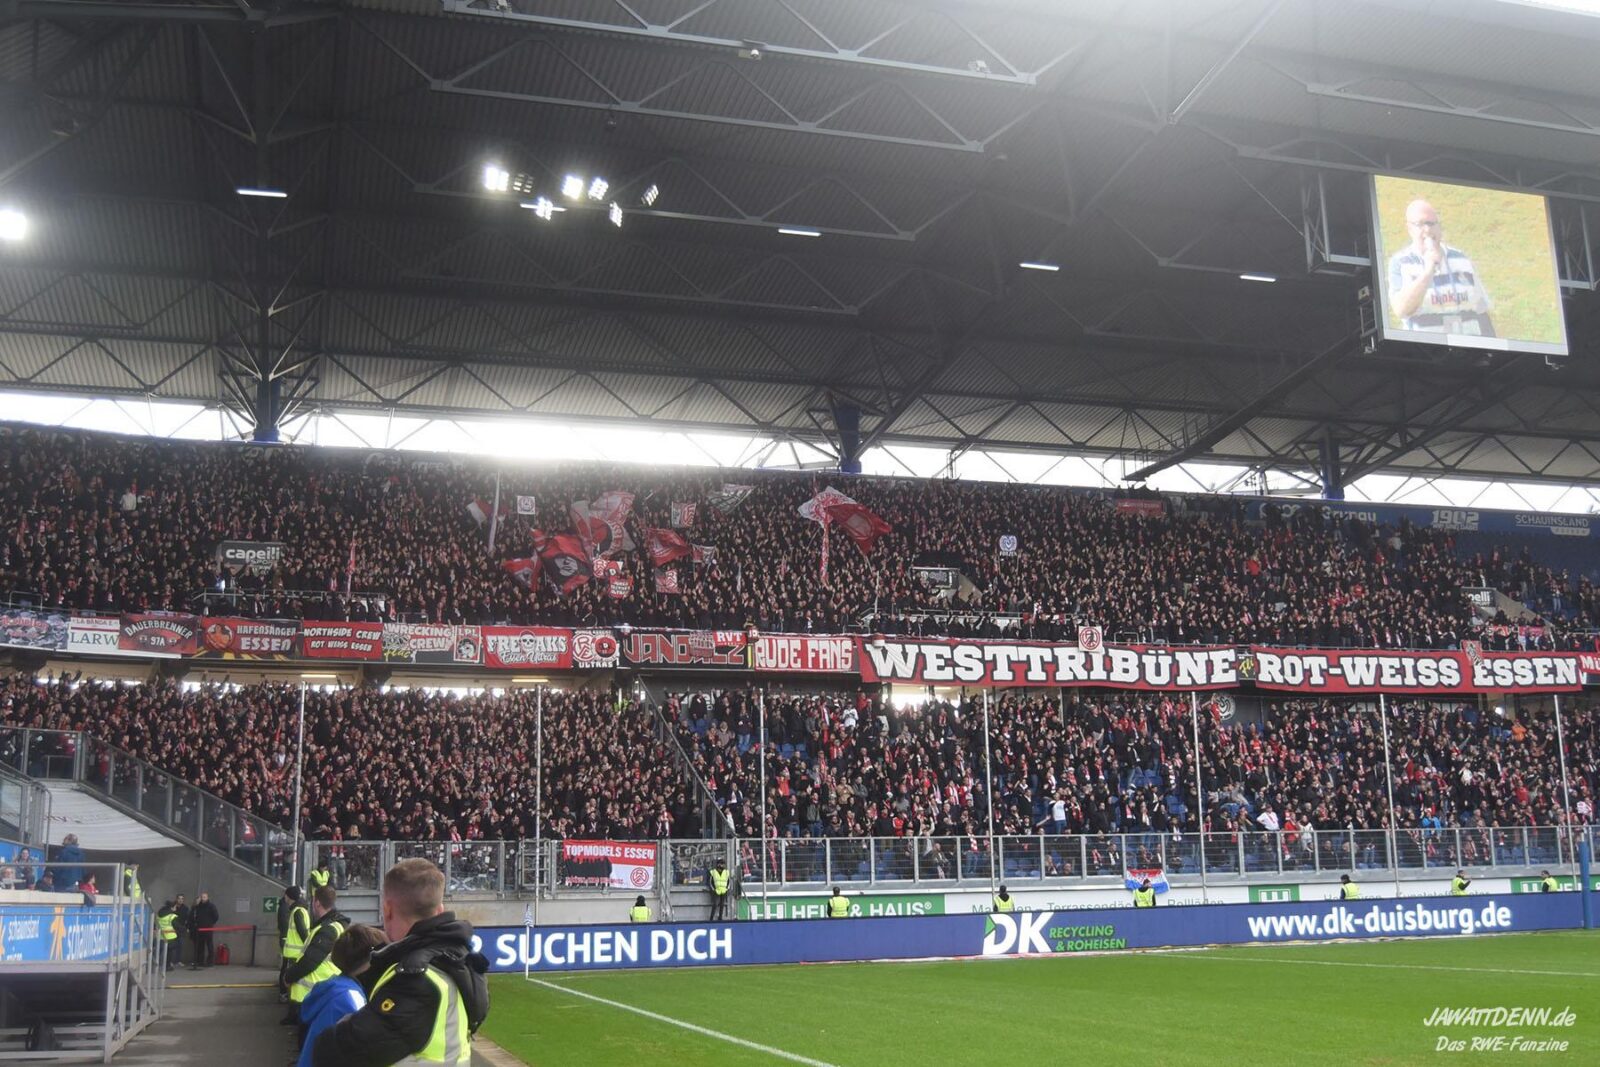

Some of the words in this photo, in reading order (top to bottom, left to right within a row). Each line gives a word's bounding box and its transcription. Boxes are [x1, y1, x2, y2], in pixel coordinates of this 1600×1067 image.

[1515, 514, 1590, 528] SCHAUINSLAND
[124, 620, 193, 640] DAUERBRENNER
[303, 627, 352, 638] NORTHSIDE
[355, 630, 382, 641] CREW
[387, 623, 452, 638] WRECKING
[459, 628, 478, 637] LPL
[715, 631, 743, 642] RVT
[310, 640, 325, 649] ROT
[409, 637, 447, 650] CREW
[755, 638, 801, 669] RUDE
[807, 639, 852, 671] FANS
[578, 661, 614, 669] ULTRAS
[865, 643, 1238, 686] WESTTRIBÜNE
[1255, 651, 1461, 687] ROT-WEISS
[1473, 656, 1578, 687] ESSEN
[565, 844, 622, 857] TOPMODELS
[624, 847, 655, 859] ESSEN
[1248, 901, 1512, 938] www.dk-duisburg.de
[982, 912, 1055, 956] DK
[1049, 925, 1114, 939] RECYCLING
[495, 931, 641, 966] SUCHEN
[650, 928, 733, 961] DICH
[1056, 941, 1065, 952] &
[1066, 938, 1126, 951] ROHEISEN
